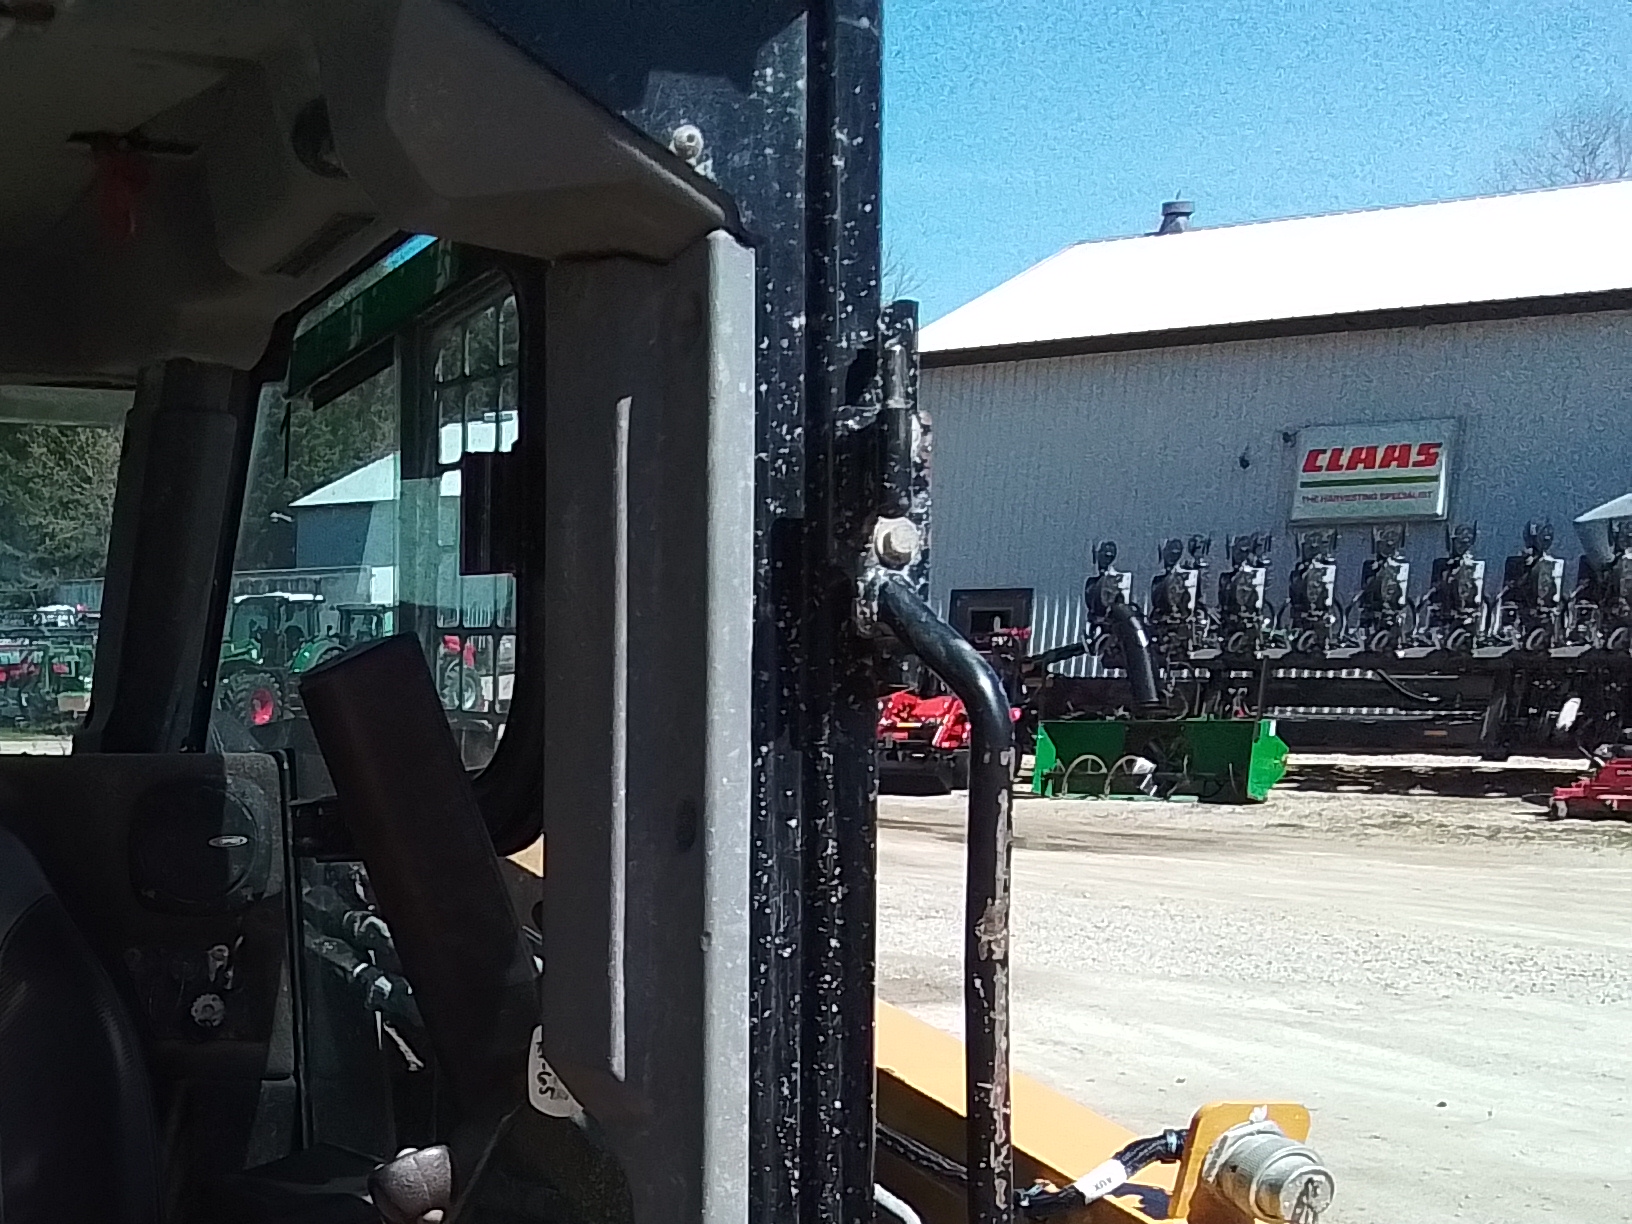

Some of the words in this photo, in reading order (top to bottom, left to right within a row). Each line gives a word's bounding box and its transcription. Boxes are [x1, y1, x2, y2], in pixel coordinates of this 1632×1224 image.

[1302, 442, 1443, 473] CLAAS
[1320, 493, 1378, 503] HARVESTING
[1380, 490, 1433, 501] SPECIALIST
